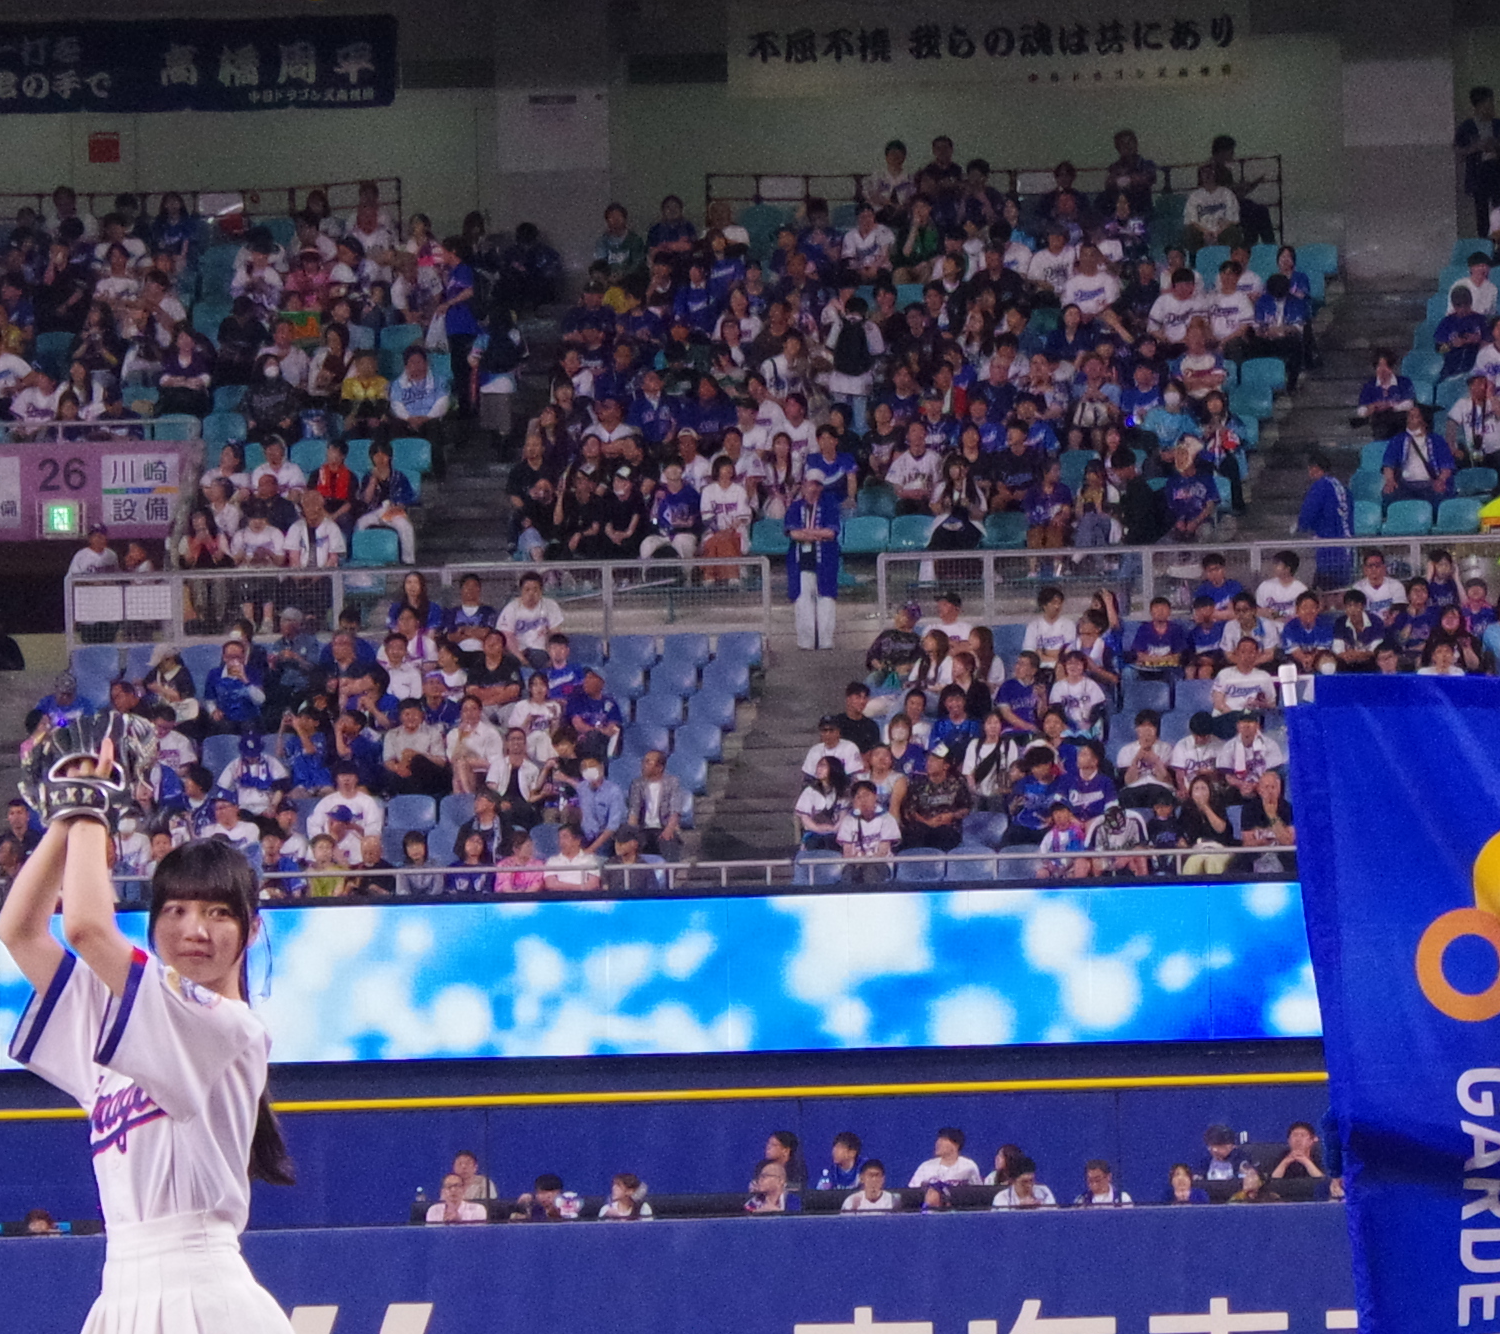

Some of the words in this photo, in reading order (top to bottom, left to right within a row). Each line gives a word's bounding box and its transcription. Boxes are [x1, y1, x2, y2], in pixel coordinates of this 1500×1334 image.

[38, 457, 87, 492] 26
[111, 460, 168, 485] 川崎
[112, 496, 170, 523] 設備
